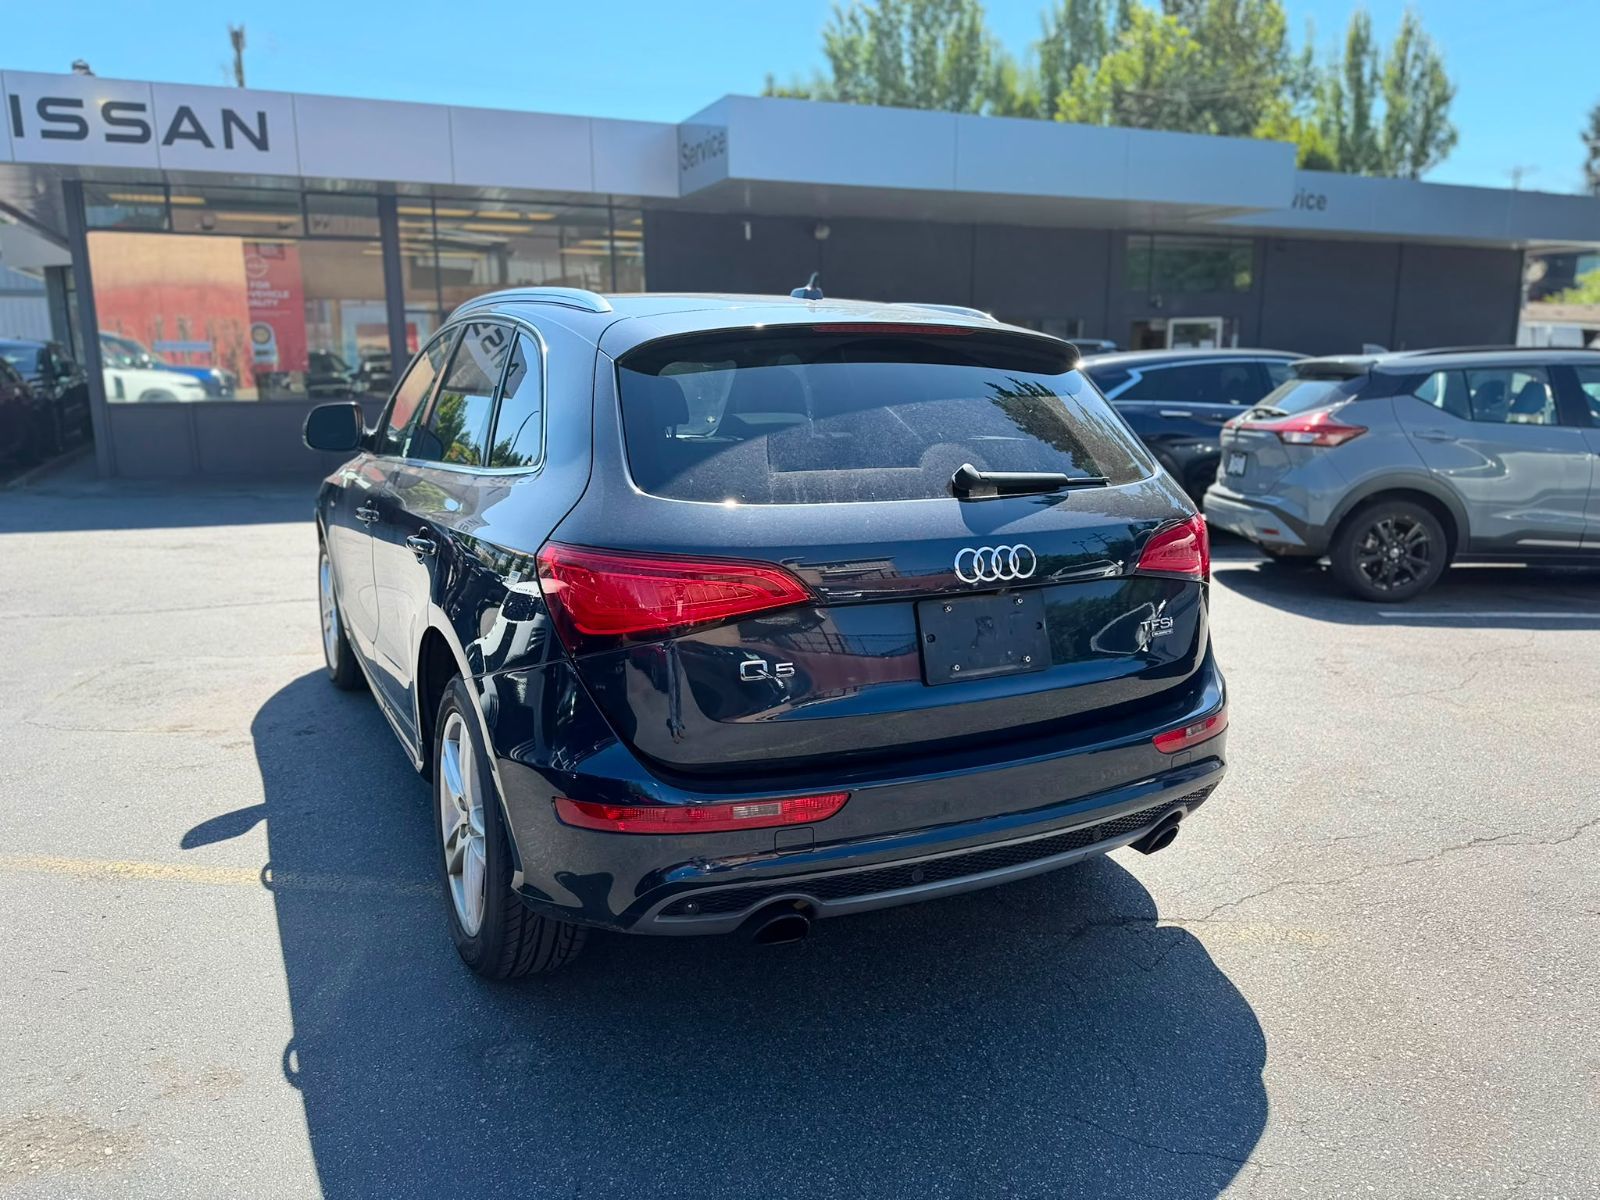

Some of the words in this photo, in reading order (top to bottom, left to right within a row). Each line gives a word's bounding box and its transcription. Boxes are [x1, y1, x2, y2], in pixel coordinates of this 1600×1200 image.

[9, 94, 270, 151] ISSAN
[682, 130, 727, 171] Service
[1140, 616, 1173, 632] TFSI
